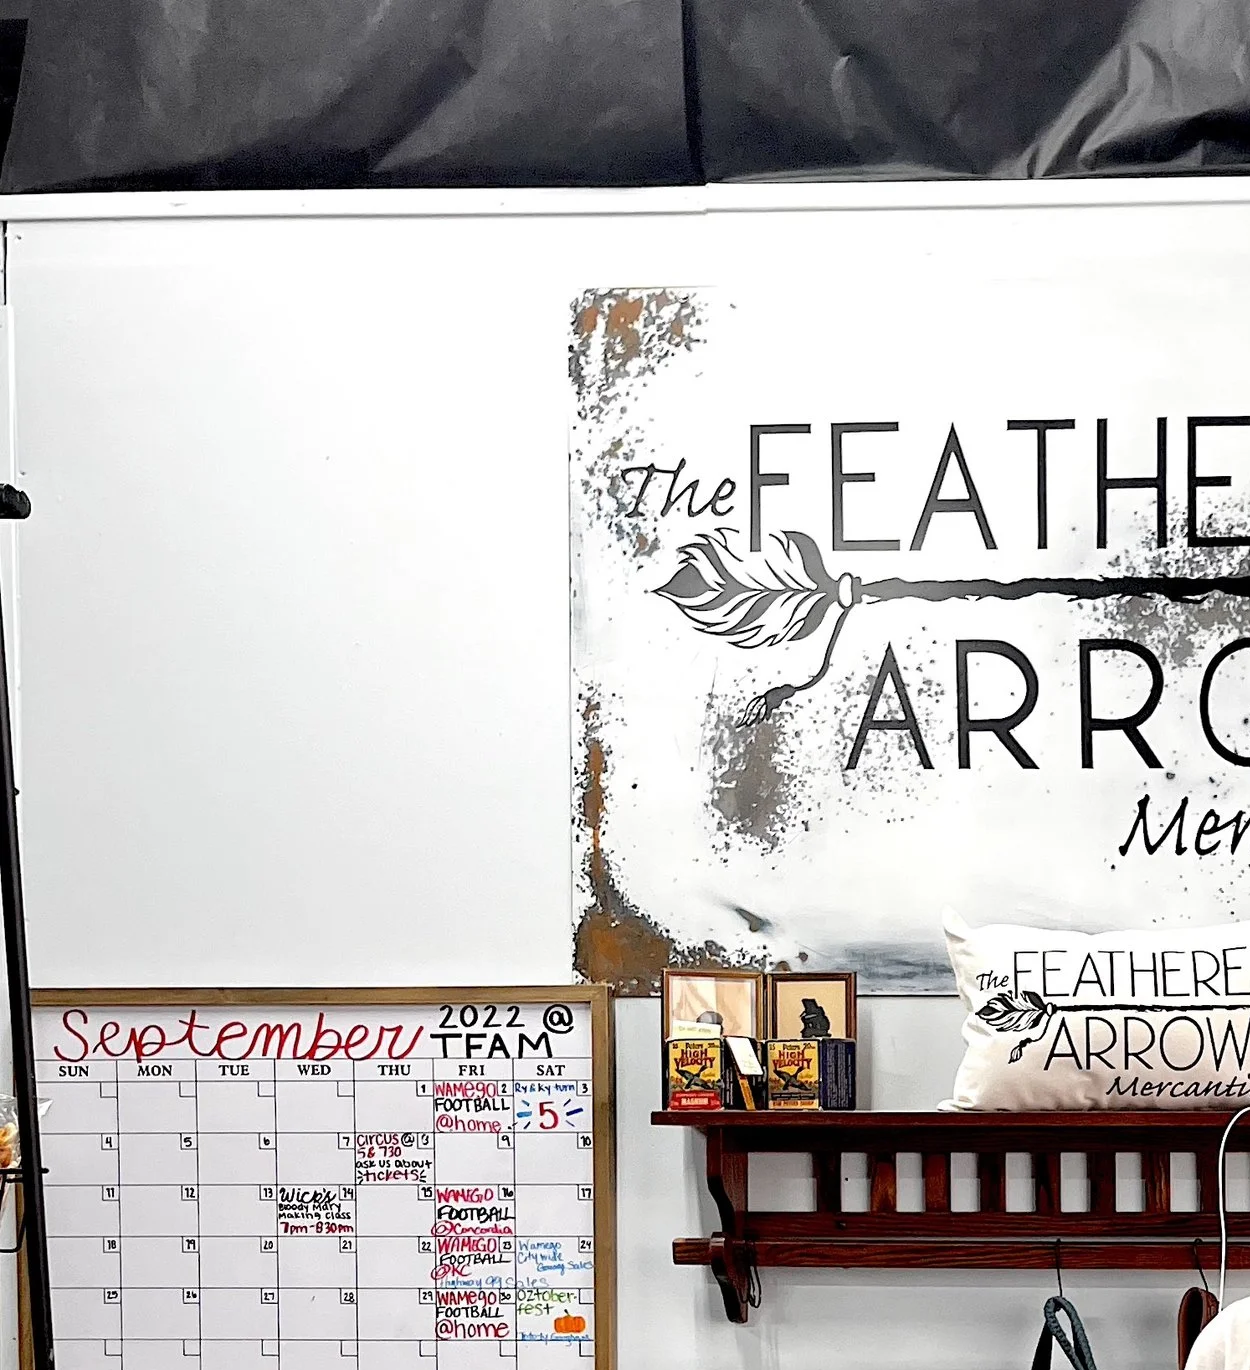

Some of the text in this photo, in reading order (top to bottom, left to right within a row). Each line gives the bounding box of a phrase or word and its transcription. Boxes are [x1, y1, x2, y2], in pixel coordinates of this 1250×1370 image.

[619, 459, 738, 519] The
[975, 970, 1009, 991] The
[438, 1003, 574, 1034] 2022 @
[54, 1009, 424, 1064] September
[430, 1031, 553, 1059] TFAM
[680, 1048, 708, 1058] HIGH
[778, 1050, 805, 1059] HIGH
[674, 1057, 716, 1070] VELOCITY
[772, 1058, 812, 1070] VELOCITY
[58, 1064, 565, 1077] SUN MON TUE WED THU FRI SAT
[501, 1084, 507, 1094] 2
[582, 1083, 589, 1093] 3
[435, 1098, 510, 1113] FOOTBALL
[539, 1101, 560, 1130] 5
[105, 1136, 113, 1148] 4
[183, 1137, 193, 1148] 5
[341, 1136, 350, 1147] 7
[501, 1135, 511, 1147] 9
[106, 1188, 115, 1199] 11
[185, 1188, 196, 1199] 12
[263, 1188, 273, 1199] 13
[342, 1187, 354, 1199] 14
[420, 1187, 433, 1198] 15
[437, 1205, 516, 1223] FOOTBALL
[106, 1239, 117, 1250] 18
[186, 1239, 196, 1250] 19
[263, 1240, 273, 1250] 20
[342, 1240, 352, 1250] 21
[421, 1241, 432, 1251] 22
[503, 1242, 512, 1250] 23
[580, 1240, 592, 1250] 24
[440, 1253, 512, 1265] FOOTBALL
[263, 1291, 275, 1301] 27
[436, 1305, 504, 1318] FOOTBALL
